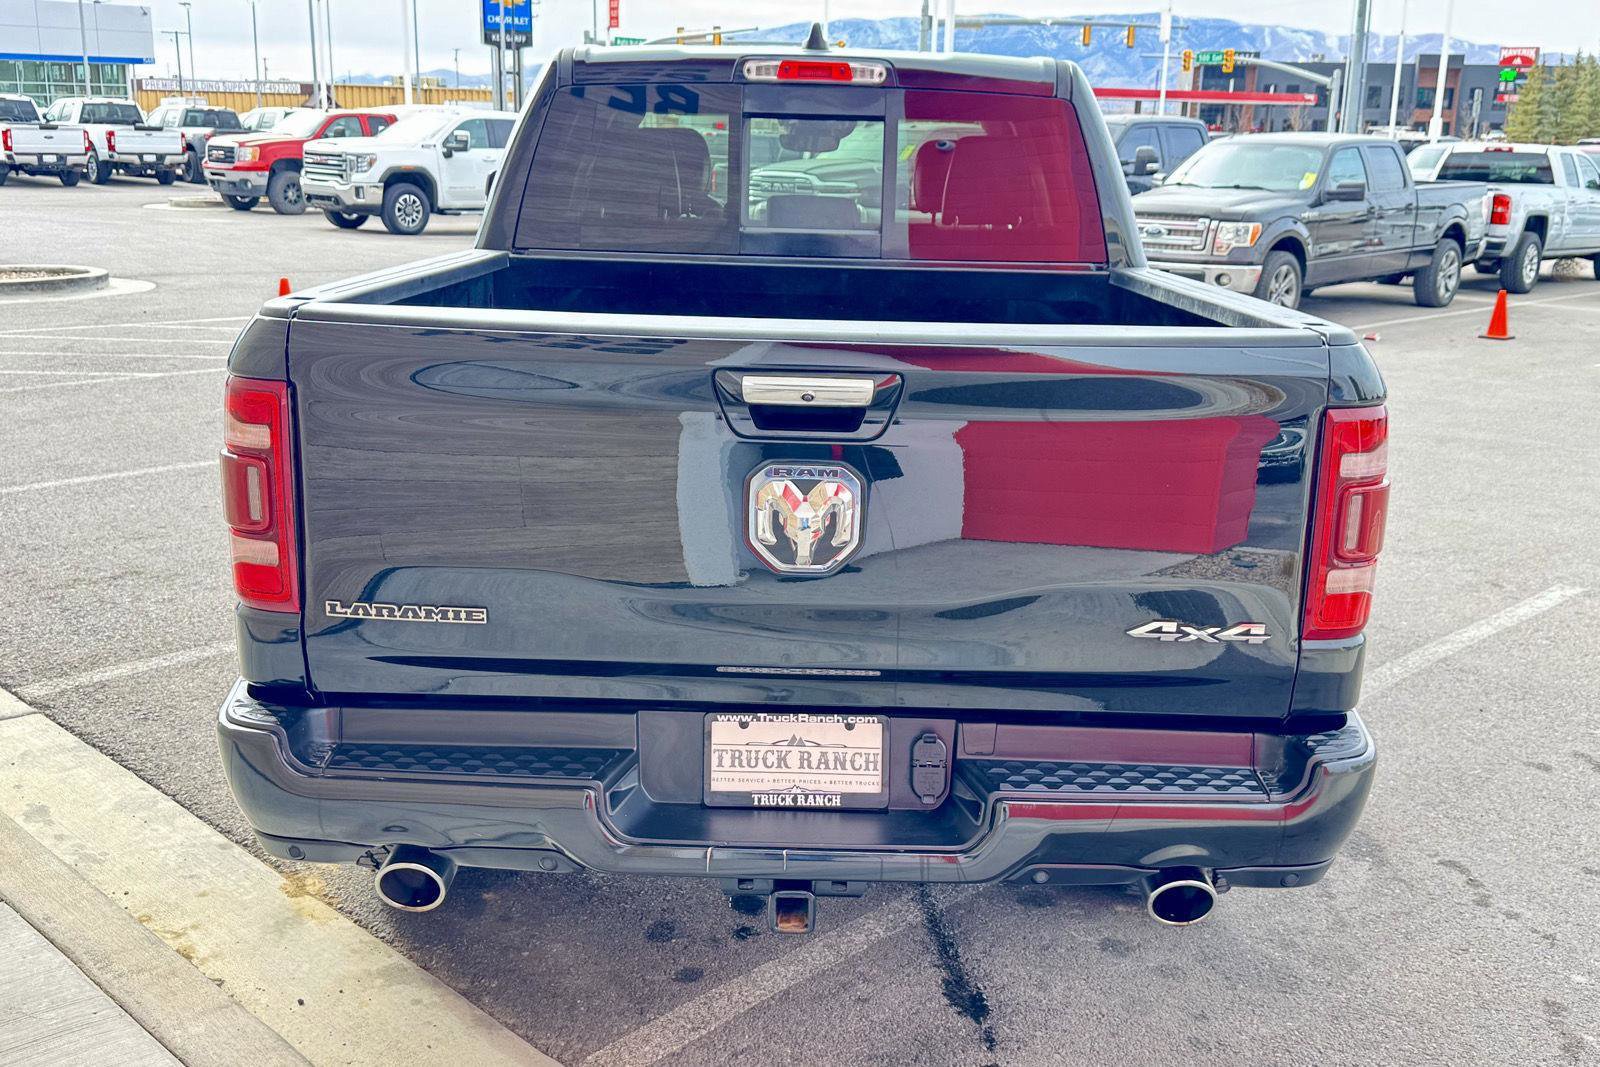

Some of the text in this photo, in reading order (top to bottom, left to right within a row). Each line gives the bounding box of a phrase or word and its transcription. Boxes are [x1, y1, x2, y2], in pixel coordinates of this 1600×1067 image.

[183, 80, 220, 91] BULDING
[223, 81, 251, 92] SUPPLY
[772, 467, 840, 478] RAM
[325, 600, 488, 624] LARAMIE
[1126, 620, 1272, 645] 4x4
[716, 713, 878, 724] www.TruckRanch.com
[713, 748, 880, 772] TRUCK RANCH
[751, 793, 841, 806] TRUCK RANCH
